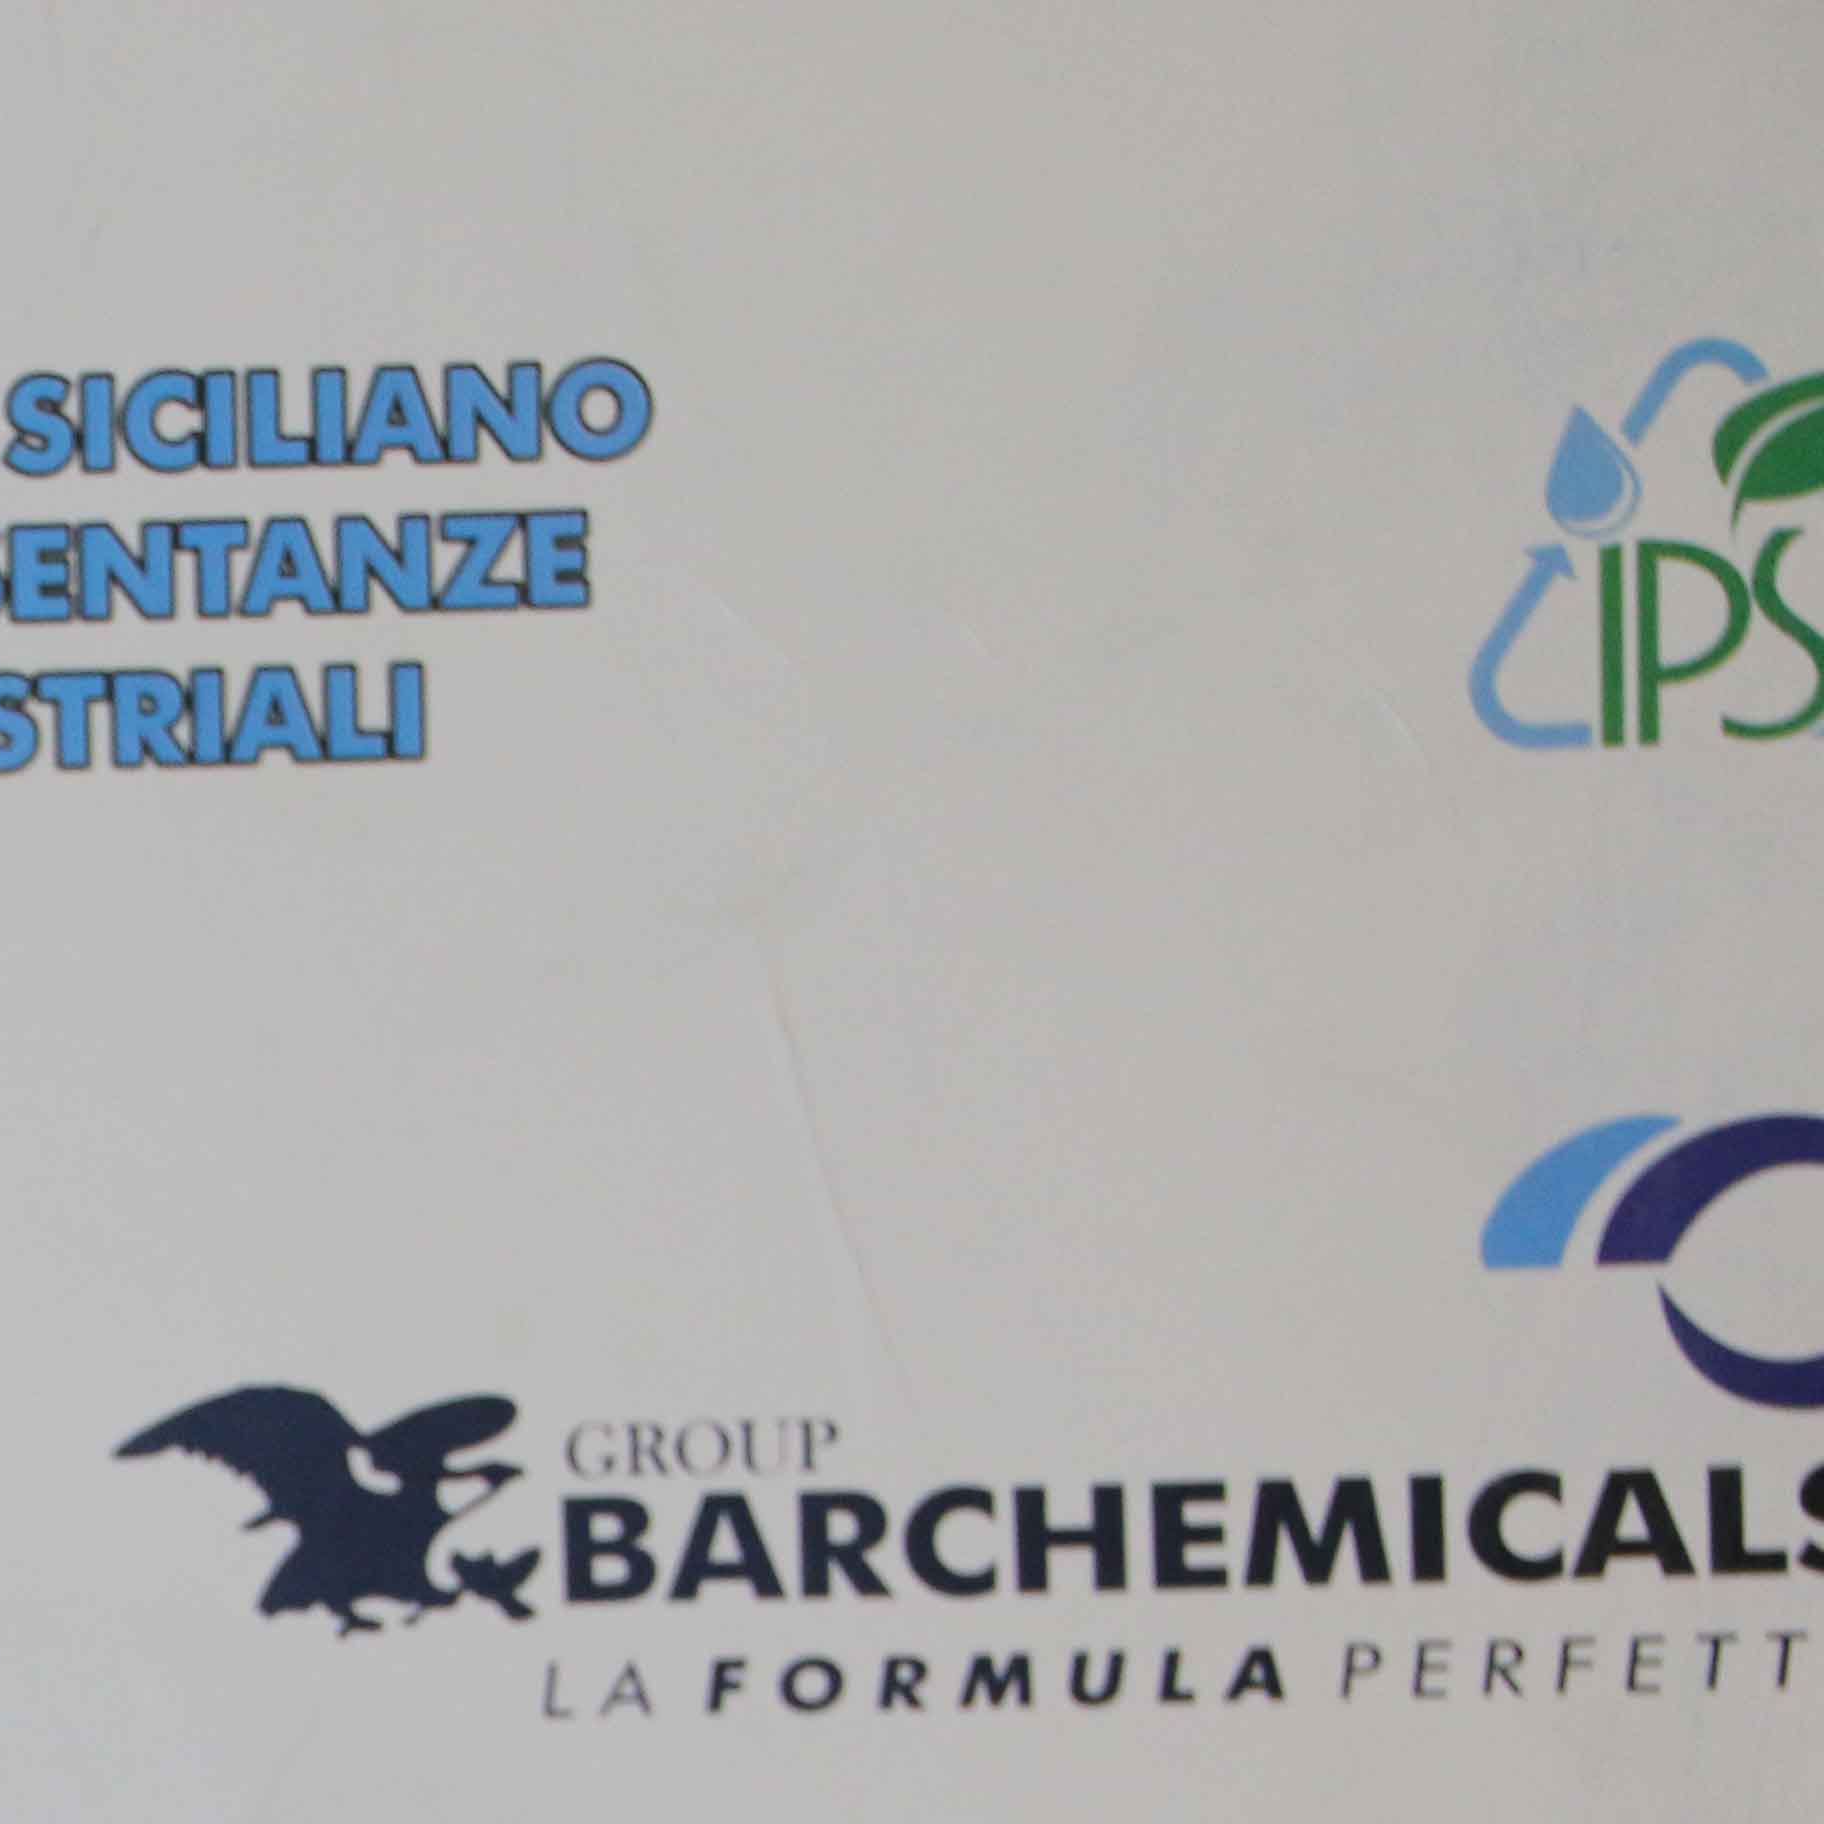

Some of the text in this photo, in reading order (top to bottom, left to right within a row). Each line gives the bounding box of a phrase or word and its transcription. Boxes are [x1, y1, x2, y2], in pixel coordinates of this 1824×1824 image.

[2, 357, 654, 475] SICILIANO
[565, 1417, 839, 1477] GROUP
[541, 1662, 654, 1720] LA
[706, 1646, 1286, 1714] FORMULA
